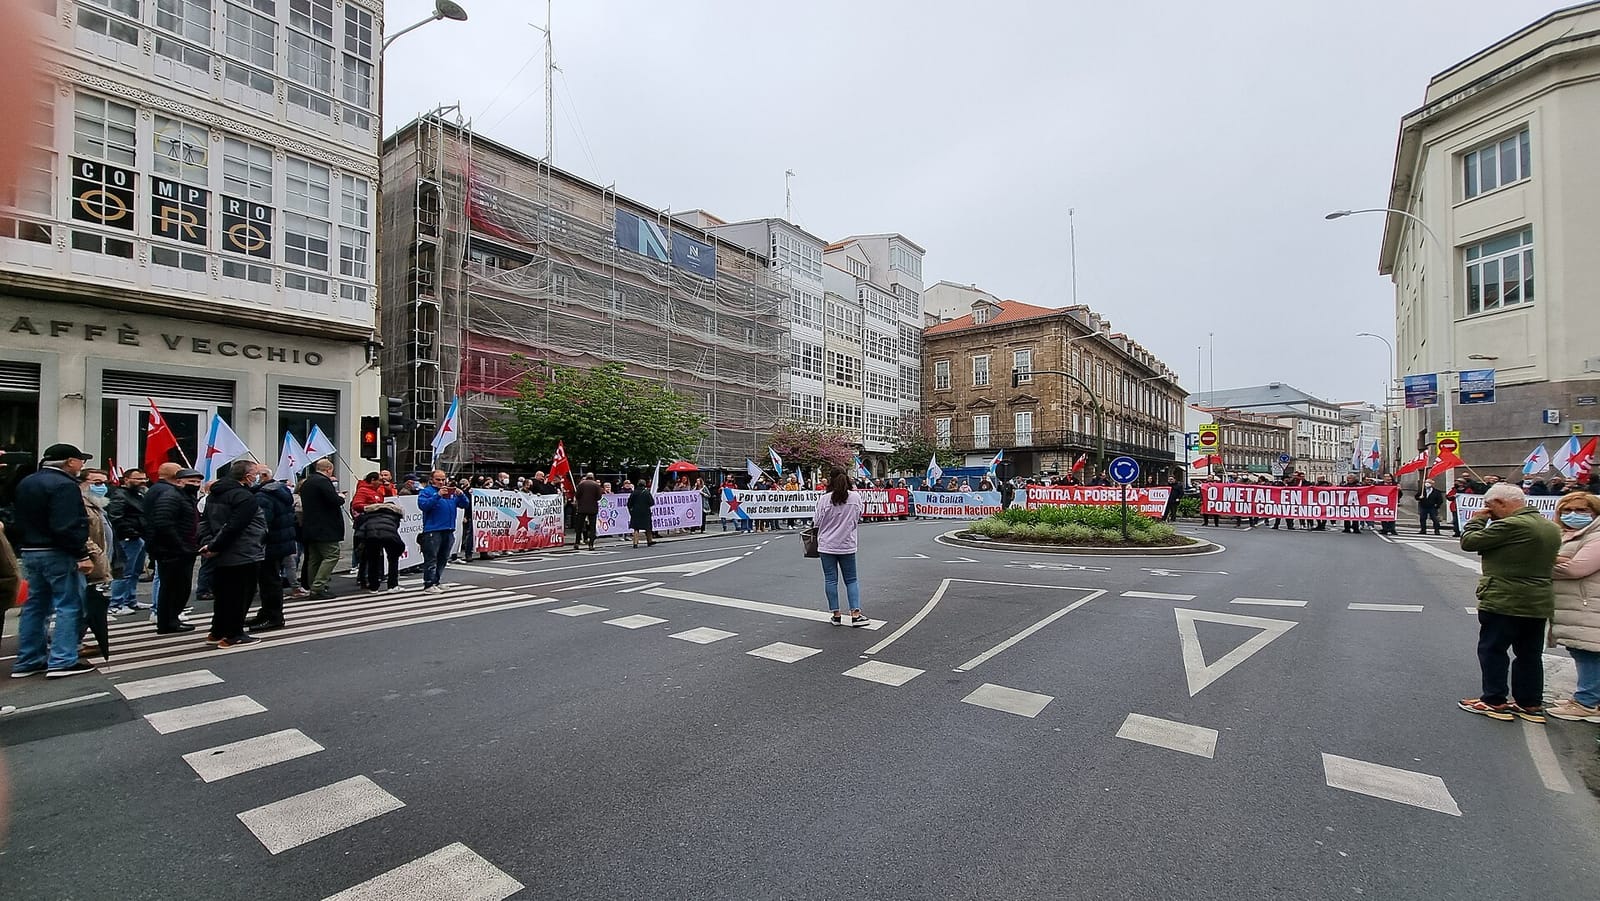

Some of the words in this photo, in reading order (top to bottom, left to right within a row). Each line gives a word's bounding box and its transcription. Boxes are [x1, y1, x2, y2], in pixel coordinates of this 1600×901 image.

[161, 334, 323, 366] VECCHIO
[474, 494, 522, 509] PANADERÍAS
[656, 494, 698, 506] ABALLADORAS
[738, 493, 753, 502] Por
[755, 493, 766, 502] un
[768, 493, 804, 503] convenio
[806, 492, 821, 502] XUST
[926, 494, 937, 503] Na
[939, 494, 964, 503] Galiza
[1029, 489, 1070, 500] CONTRA
[1073, 489, 1081, 501] A
[1084, 489, 1139, 502] POBREZA
[1208, 486, 1217, 501] O
[1222, 487, 1274, 504] METAL
[1280, 489, 1302, 505] EN
[1308, 490, 1360, 506] LOITA
[782, 505, 790, 513] de
[1140, 504, 1162, 513] DIGNO
[1207, 500, 1232, 513] POR
[1235, 503, 1252, 514] UN
[1256, 504, 1322, 518] CONVENIO
[1325, 506, 1369, 518] DIGNO
[1462, 497, 1483, 510] LOIT
[1536, 500, 1555, 511] UNH
[964, 505, 1002, 516] Naciona
